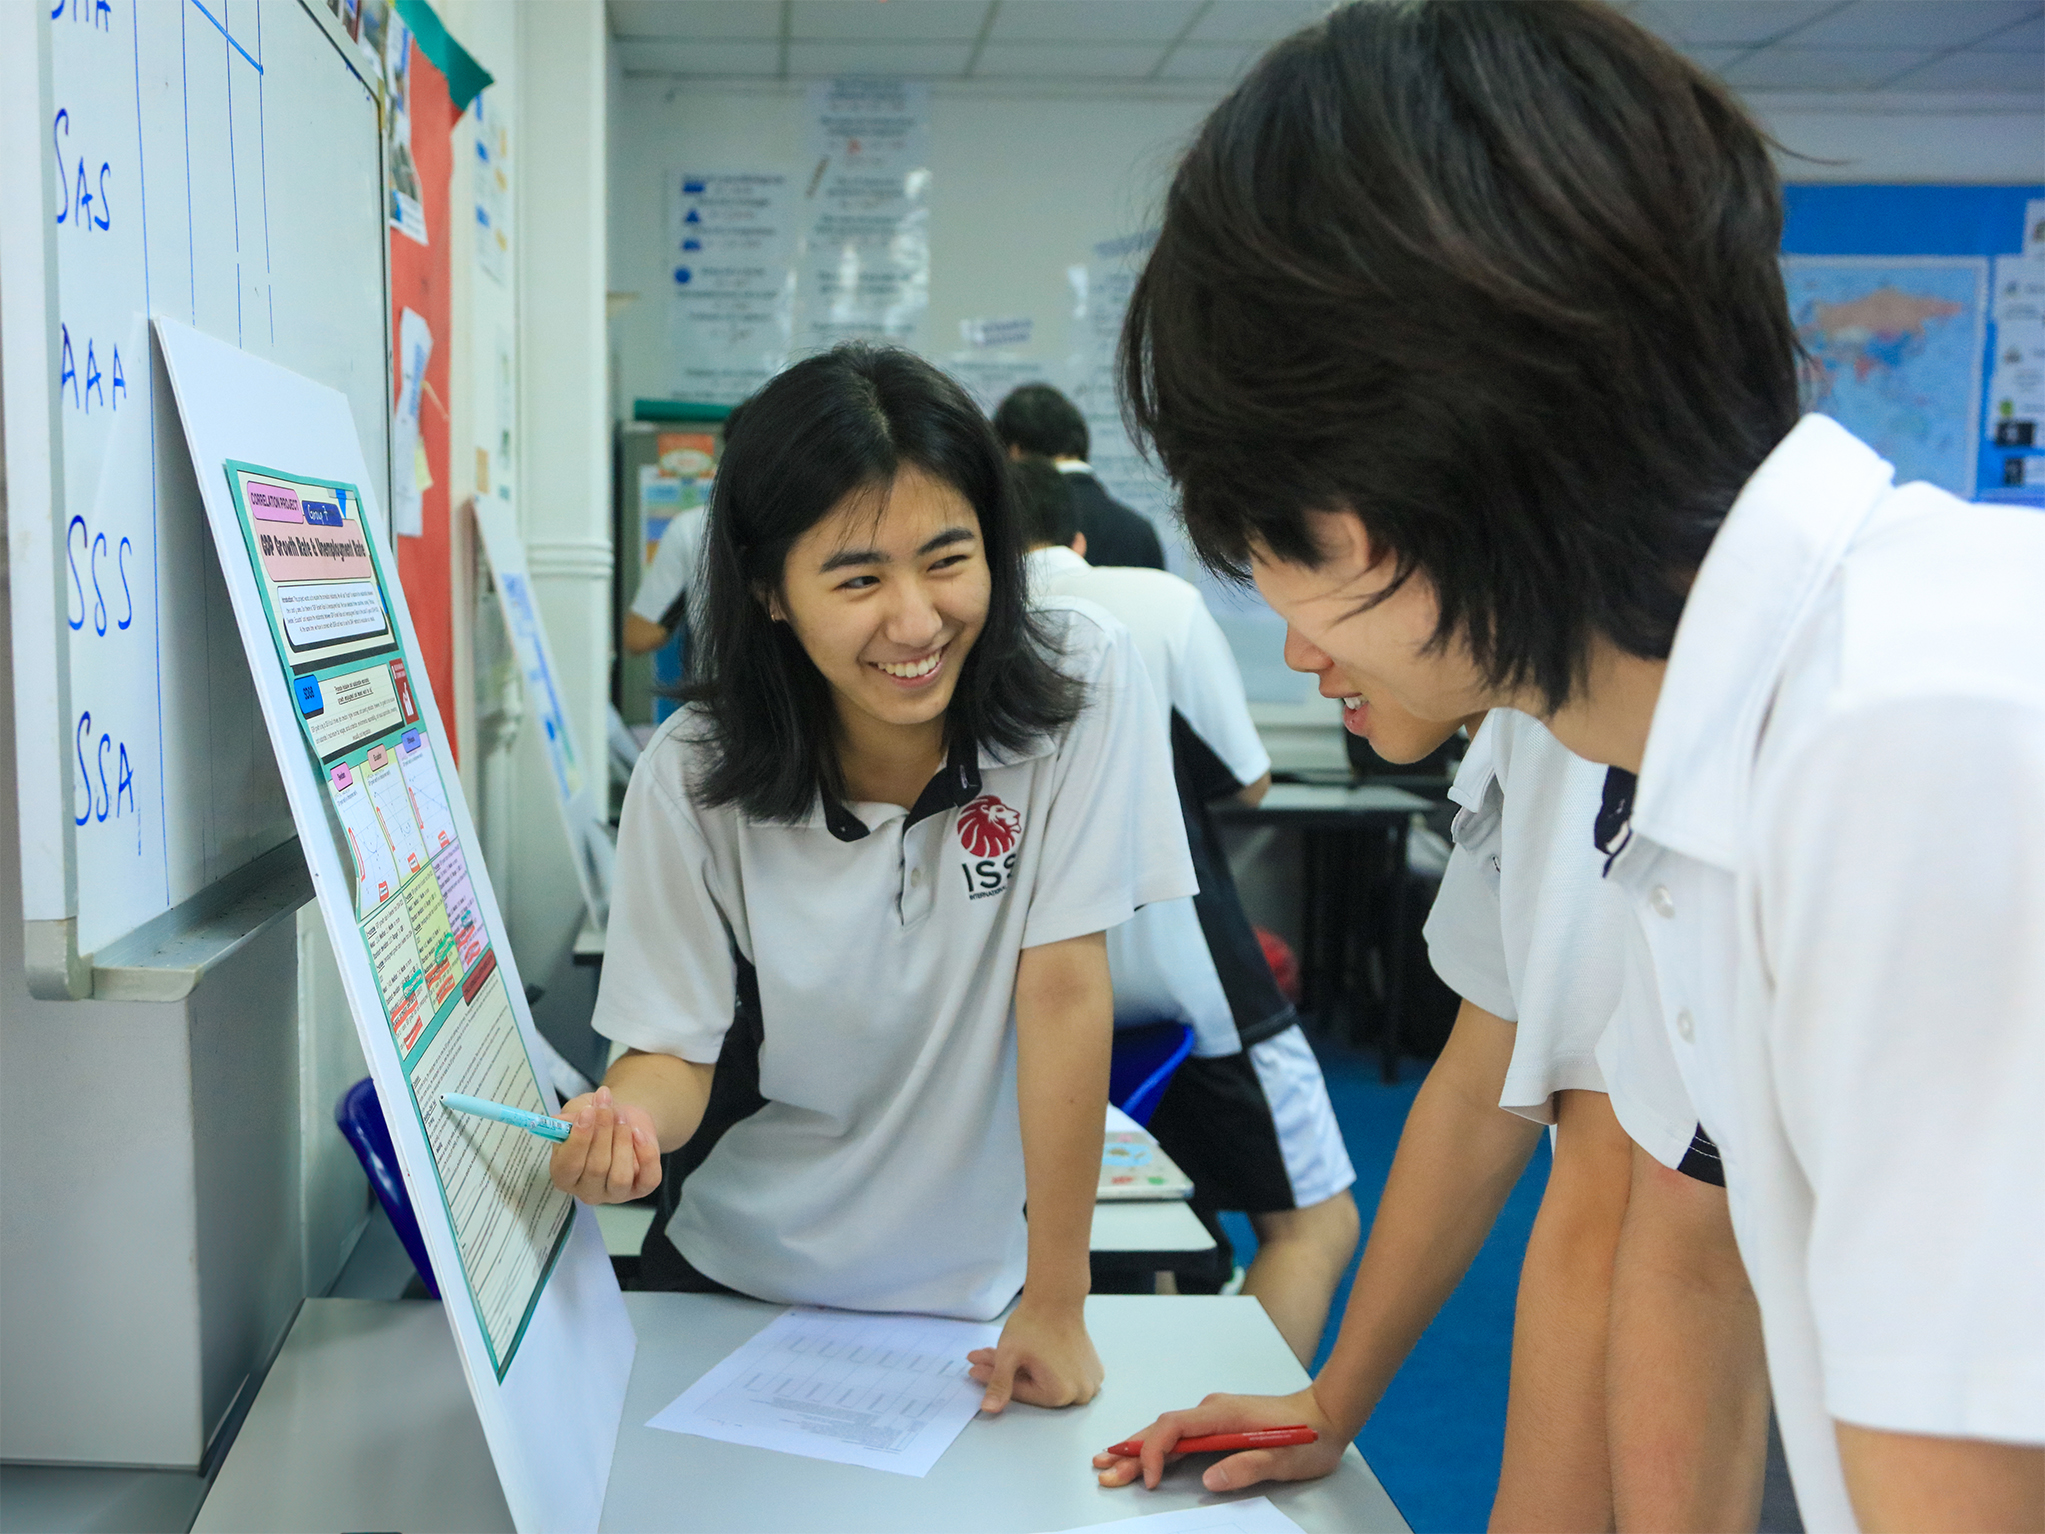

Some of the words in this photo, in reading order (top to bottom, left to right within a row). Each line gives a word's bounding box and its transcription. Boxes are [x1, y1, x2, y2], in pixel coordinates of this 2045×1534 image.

[54, 108, 111, 231] SAS
[61, 322, 127, 415] AAA
[273, 534, 300, 557] Growth
[296, 536, 313, 557] Rate
[315, 537, 355, 562] Unemployment
[351, 539, 367, 557] Rate
[74, 710, 134, 826] SSA
